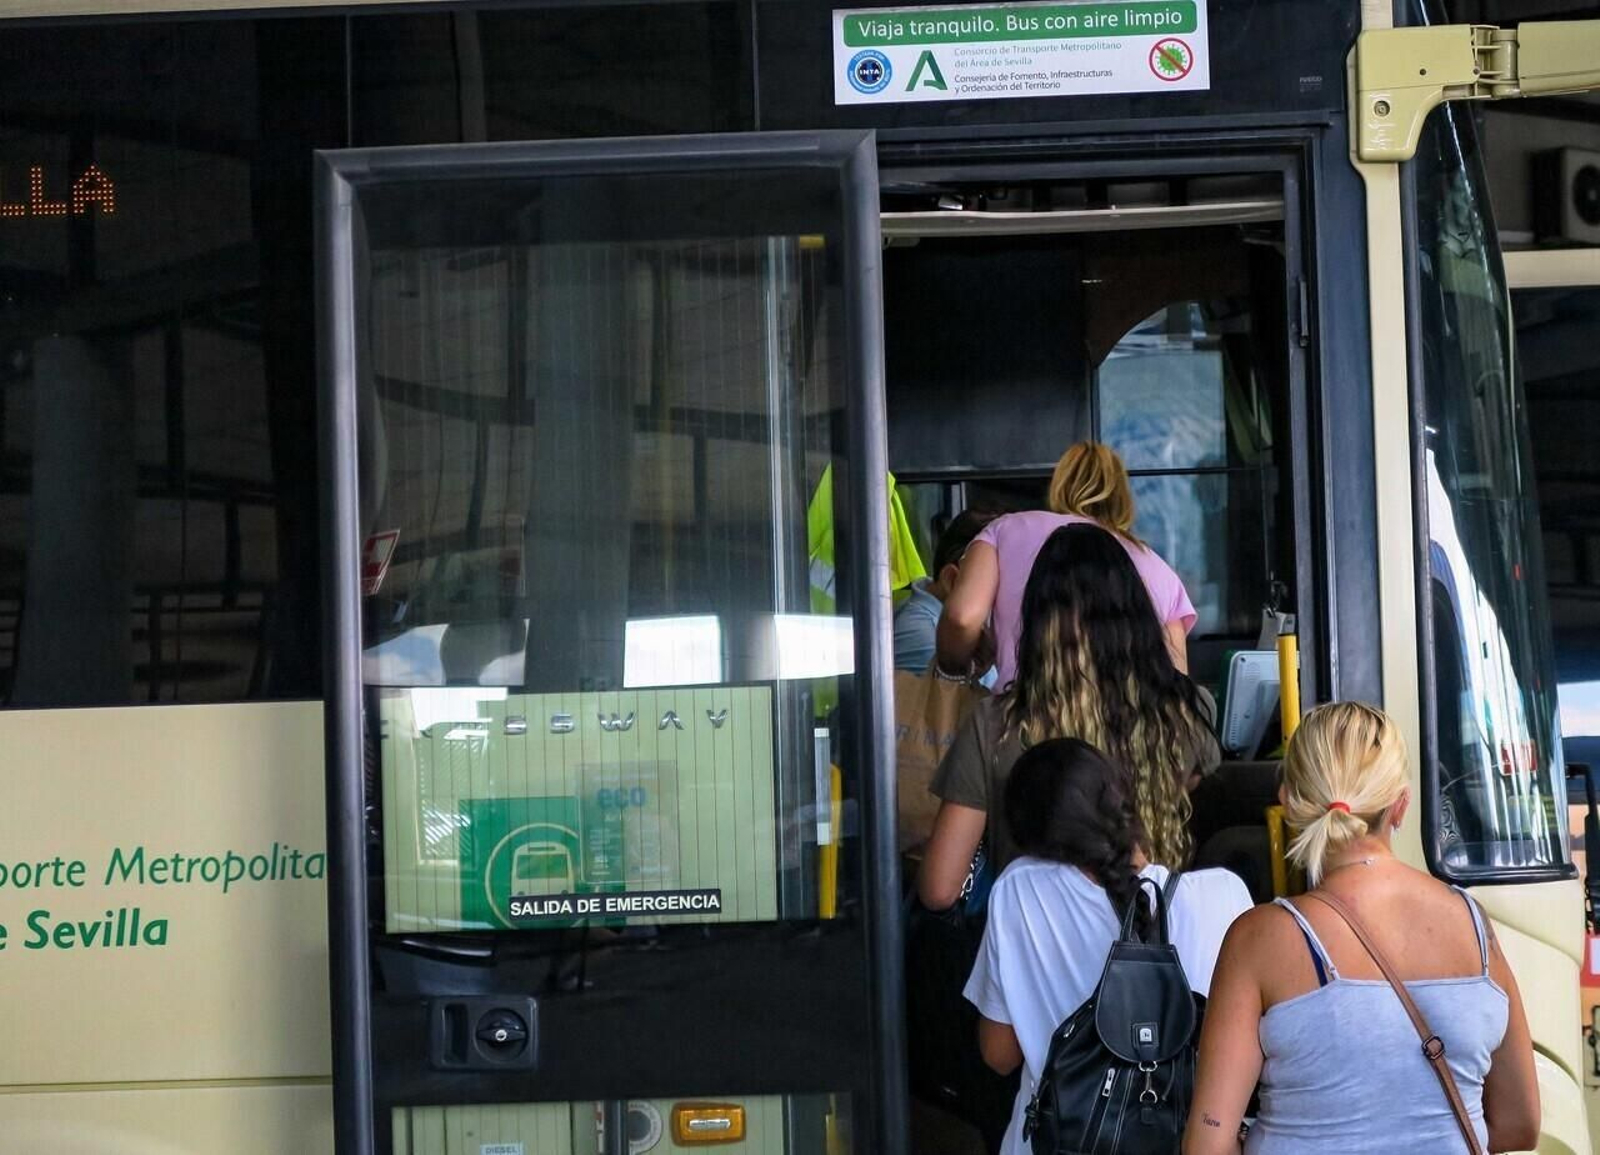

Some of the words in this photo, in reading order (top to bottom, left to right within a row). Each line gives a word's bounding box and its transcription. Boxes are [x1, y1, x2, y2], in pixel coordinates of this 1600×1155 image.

[858, 20, 903, 39] Viaja
[909, 19, 999, 37] tranquilo.
[1006, 15, 1039, 31] Bus
[1045, 17, 1077, 30] con
[1084, 12, 1118, 28] aire
[1124, 9, 1183, 30] limpio
[954, 47, 997, 56] Consorcio
[999, 46, 1010, 55] de
[1012, 44, 1058, 55] Transporte
[1060, 41, 1122, 53] Metropolitano
[954, 58, 967, 68] del
[969, 57, 990, 67] Área
[992, 57, 1000, 66] de
[1002, 56, 1032, 66] Sevilla
[954, 73, 996, 83] Consejería
[998, 72, 1008, 81] de
[1010, 70, 1049, 81] Fomento,
[1050, 68, 1112, 79] Infraestructuras
[954, 85, 960, 94] y
[962, 82, 1007, 92] Ordenación
[1010, 81, 1022, 90] del
[1024, 80, 1060, 90] Territorio
[105, 842, 325, 893] Metropolita
[510, 899, 572, 916] SALIDA
[576, 898, 601, 913] DE
[606, 894, 720, 911] EMERGENCIA
[23, 907, 169, 950] Sevilla
